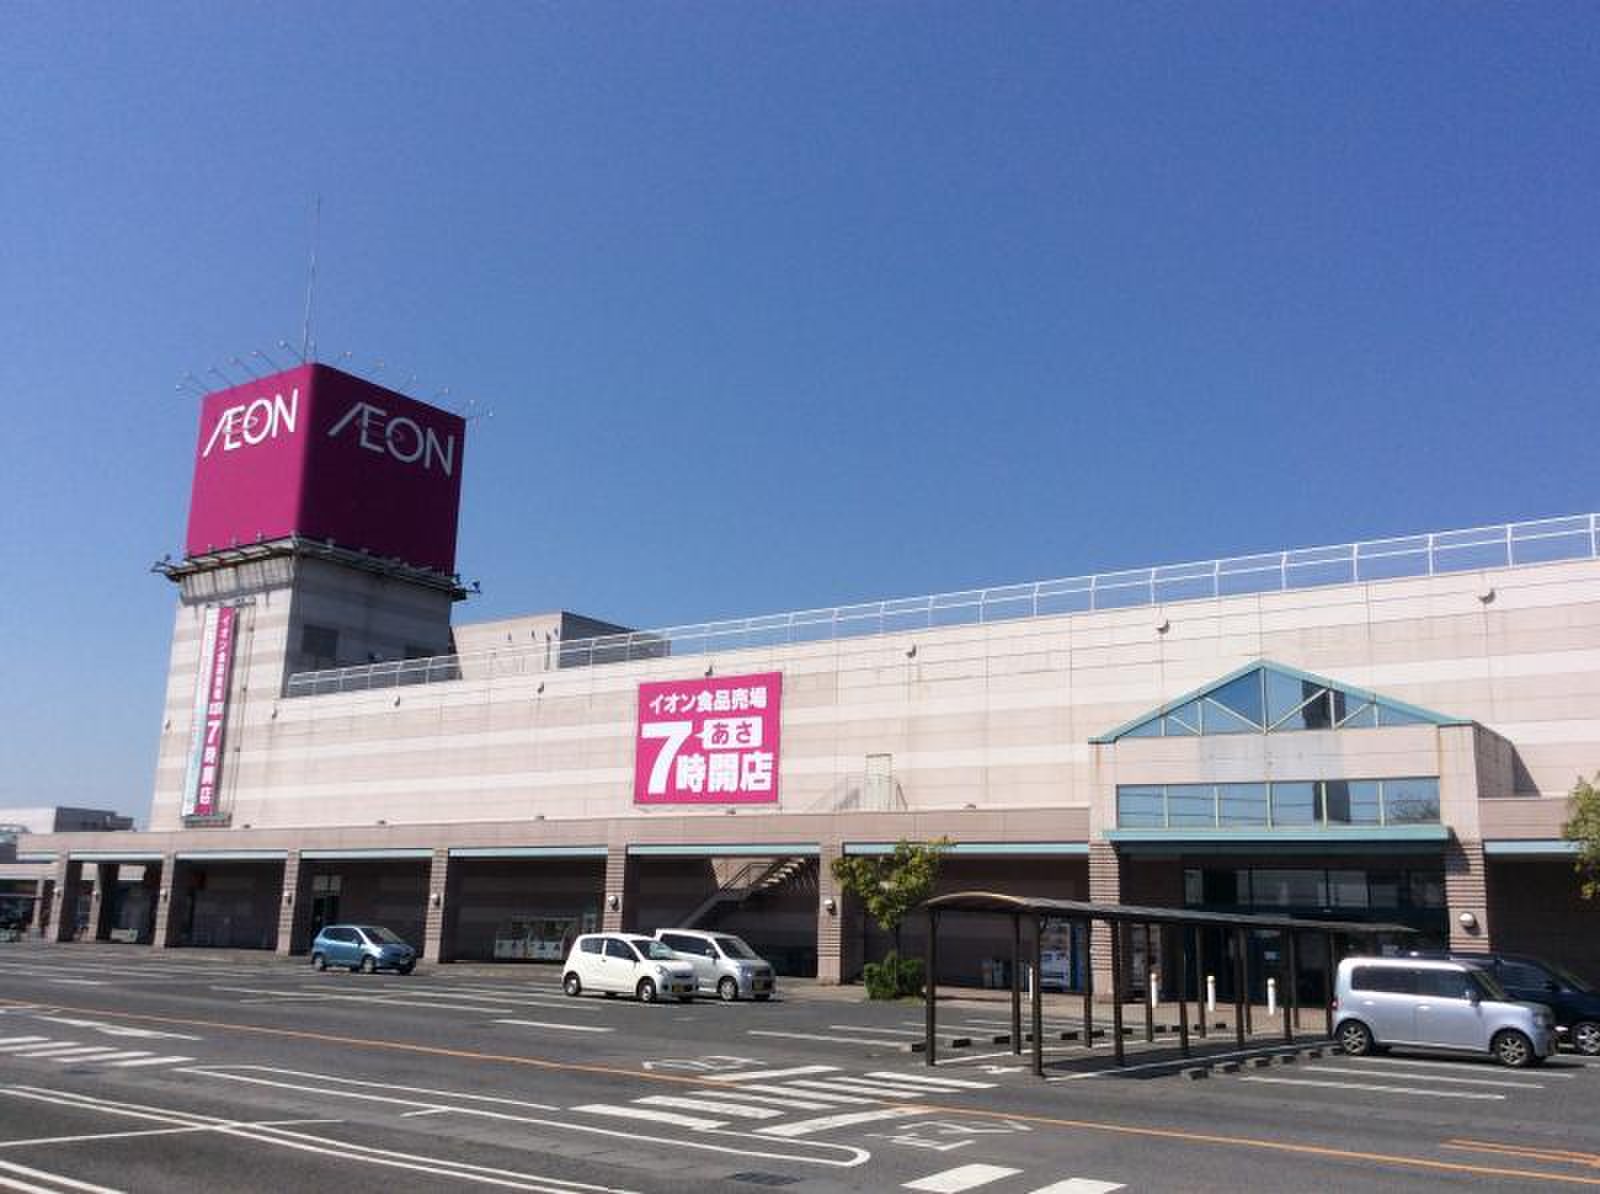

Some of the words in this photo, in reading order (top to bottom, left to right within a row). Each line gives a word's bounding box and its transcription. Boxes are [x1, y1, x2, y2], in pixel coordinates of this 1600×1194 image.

[649, 686, 767, 714] イオン食品売場
[711, 722, 752, 745] あさ
